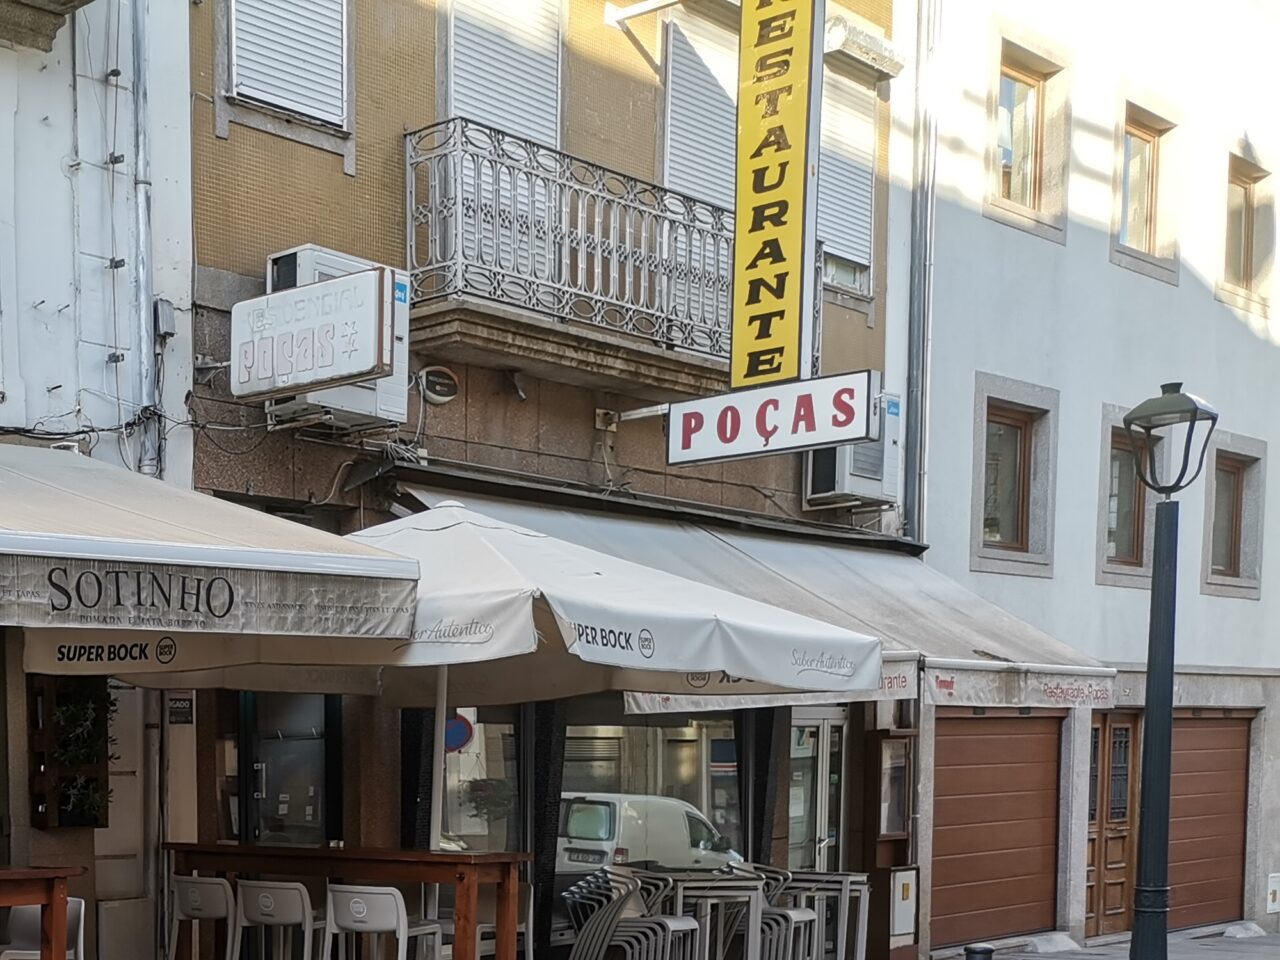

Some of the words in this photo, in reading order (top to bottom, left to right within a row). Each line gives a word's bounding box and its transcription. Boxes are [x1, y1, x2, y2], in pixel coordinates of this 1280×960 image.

[743, 0, 797, 378] ESTAURANTE
[681, 387, 856, 450] POÇAS
[16, 589, 41, 598] TAPAS
[47, 567, 235, 618] SOTINHO
[570, 622, 599, 646] PER
[600, 627, 634, 651] BOCK
[57, 644, 104, 662] SUPER
[107, 643, 150, 661] BOCK
[880, 673, 907, 690] urante
[169, 700, 190, 709] GADO
